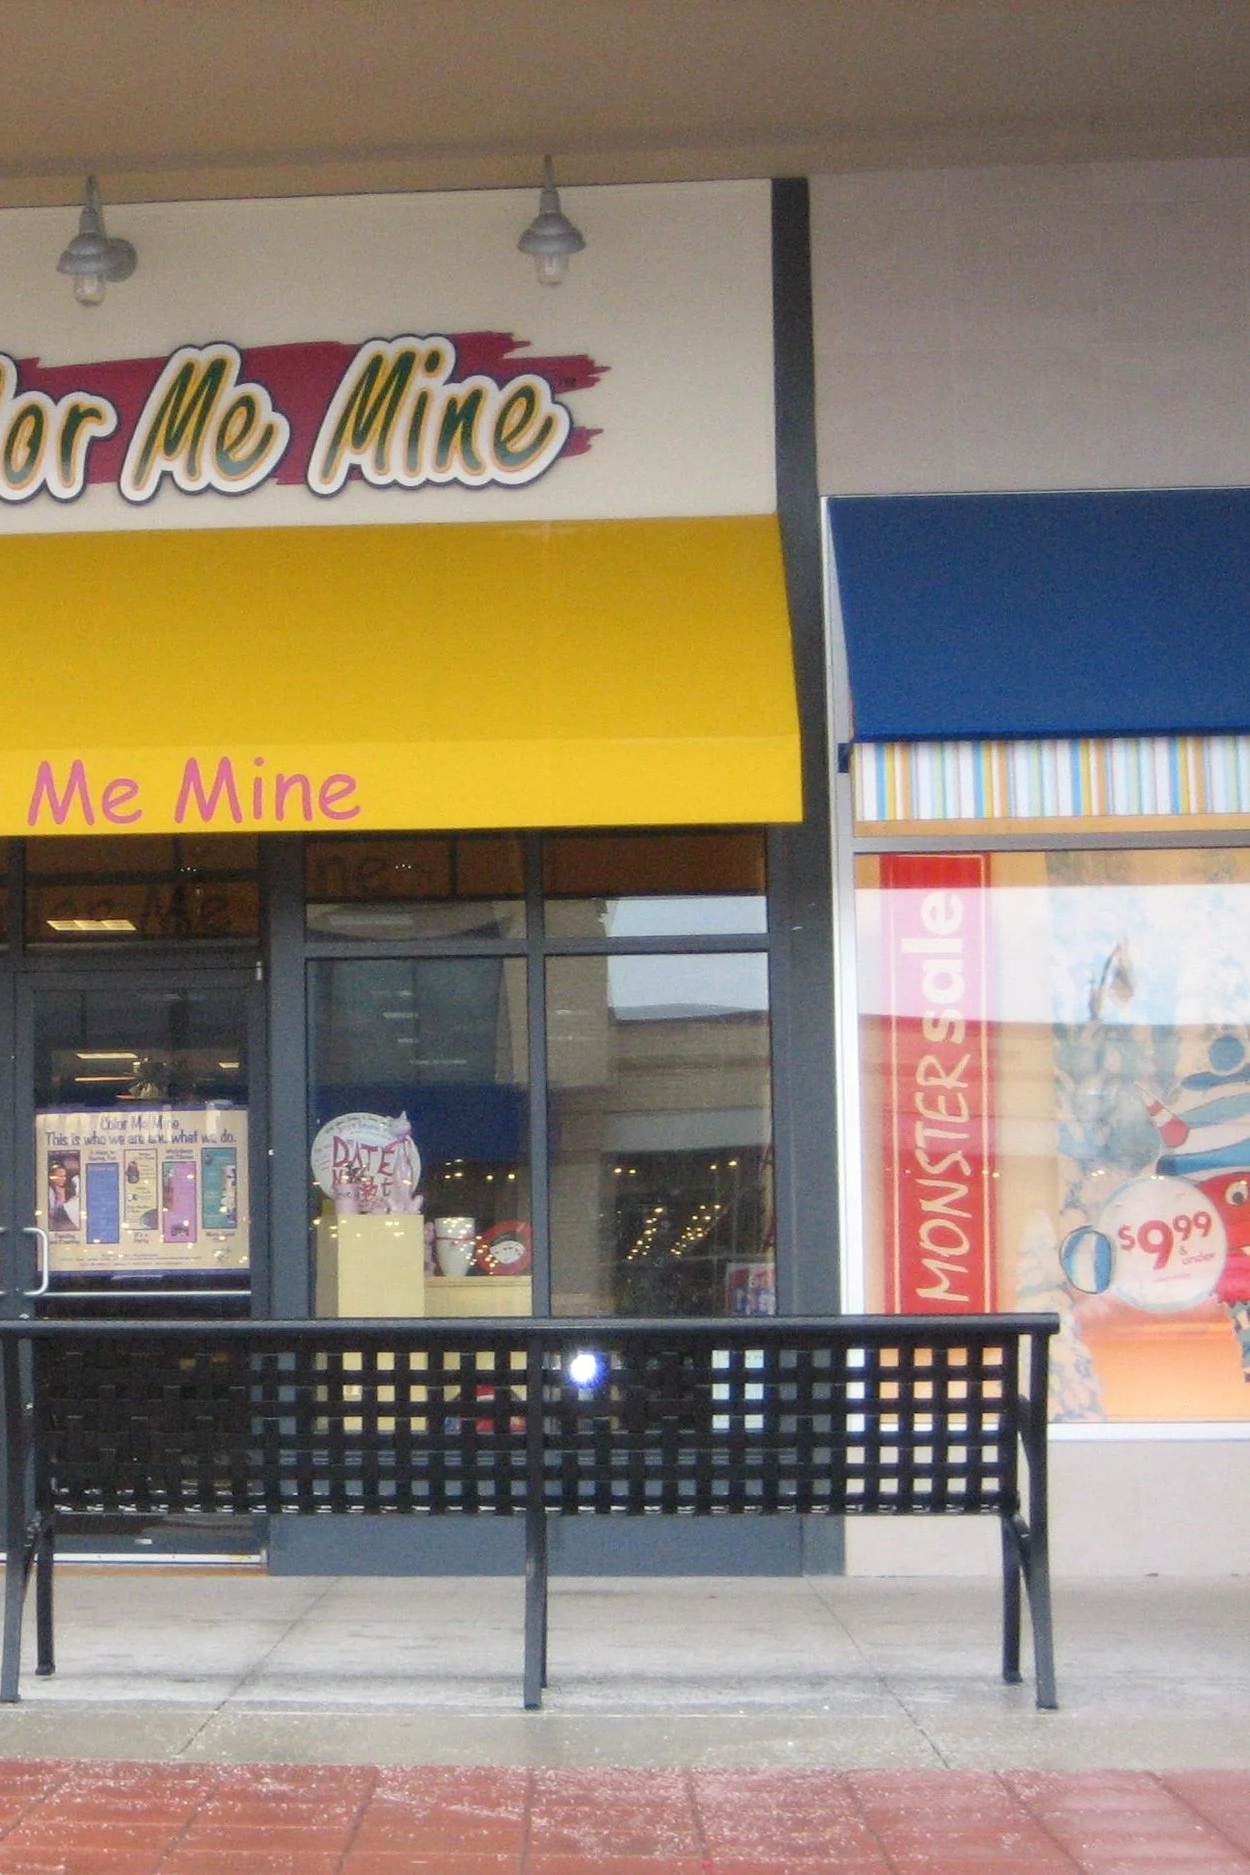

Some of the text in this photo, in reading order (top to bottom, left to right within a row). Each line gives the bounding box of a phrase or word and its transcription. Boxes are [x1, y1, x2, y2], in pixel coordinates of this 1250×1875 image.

[128, 345, 282, 496] Me
[316, 339, 558, 494] Mine
[27, 758, 143, 827] Me
[174, 755, 361, 824] Mine
[901, 889, 970, 1303] MONSTER sale
[45, 1131, 68, 1145] This
[72, 1132, 81, 1145] is
[83, 1130, 105, 1145] who
[109, 1134, 125, 1145] we
[172, 1130, 197, 1144] what
[333, 1136, 395, 1176] DATE
